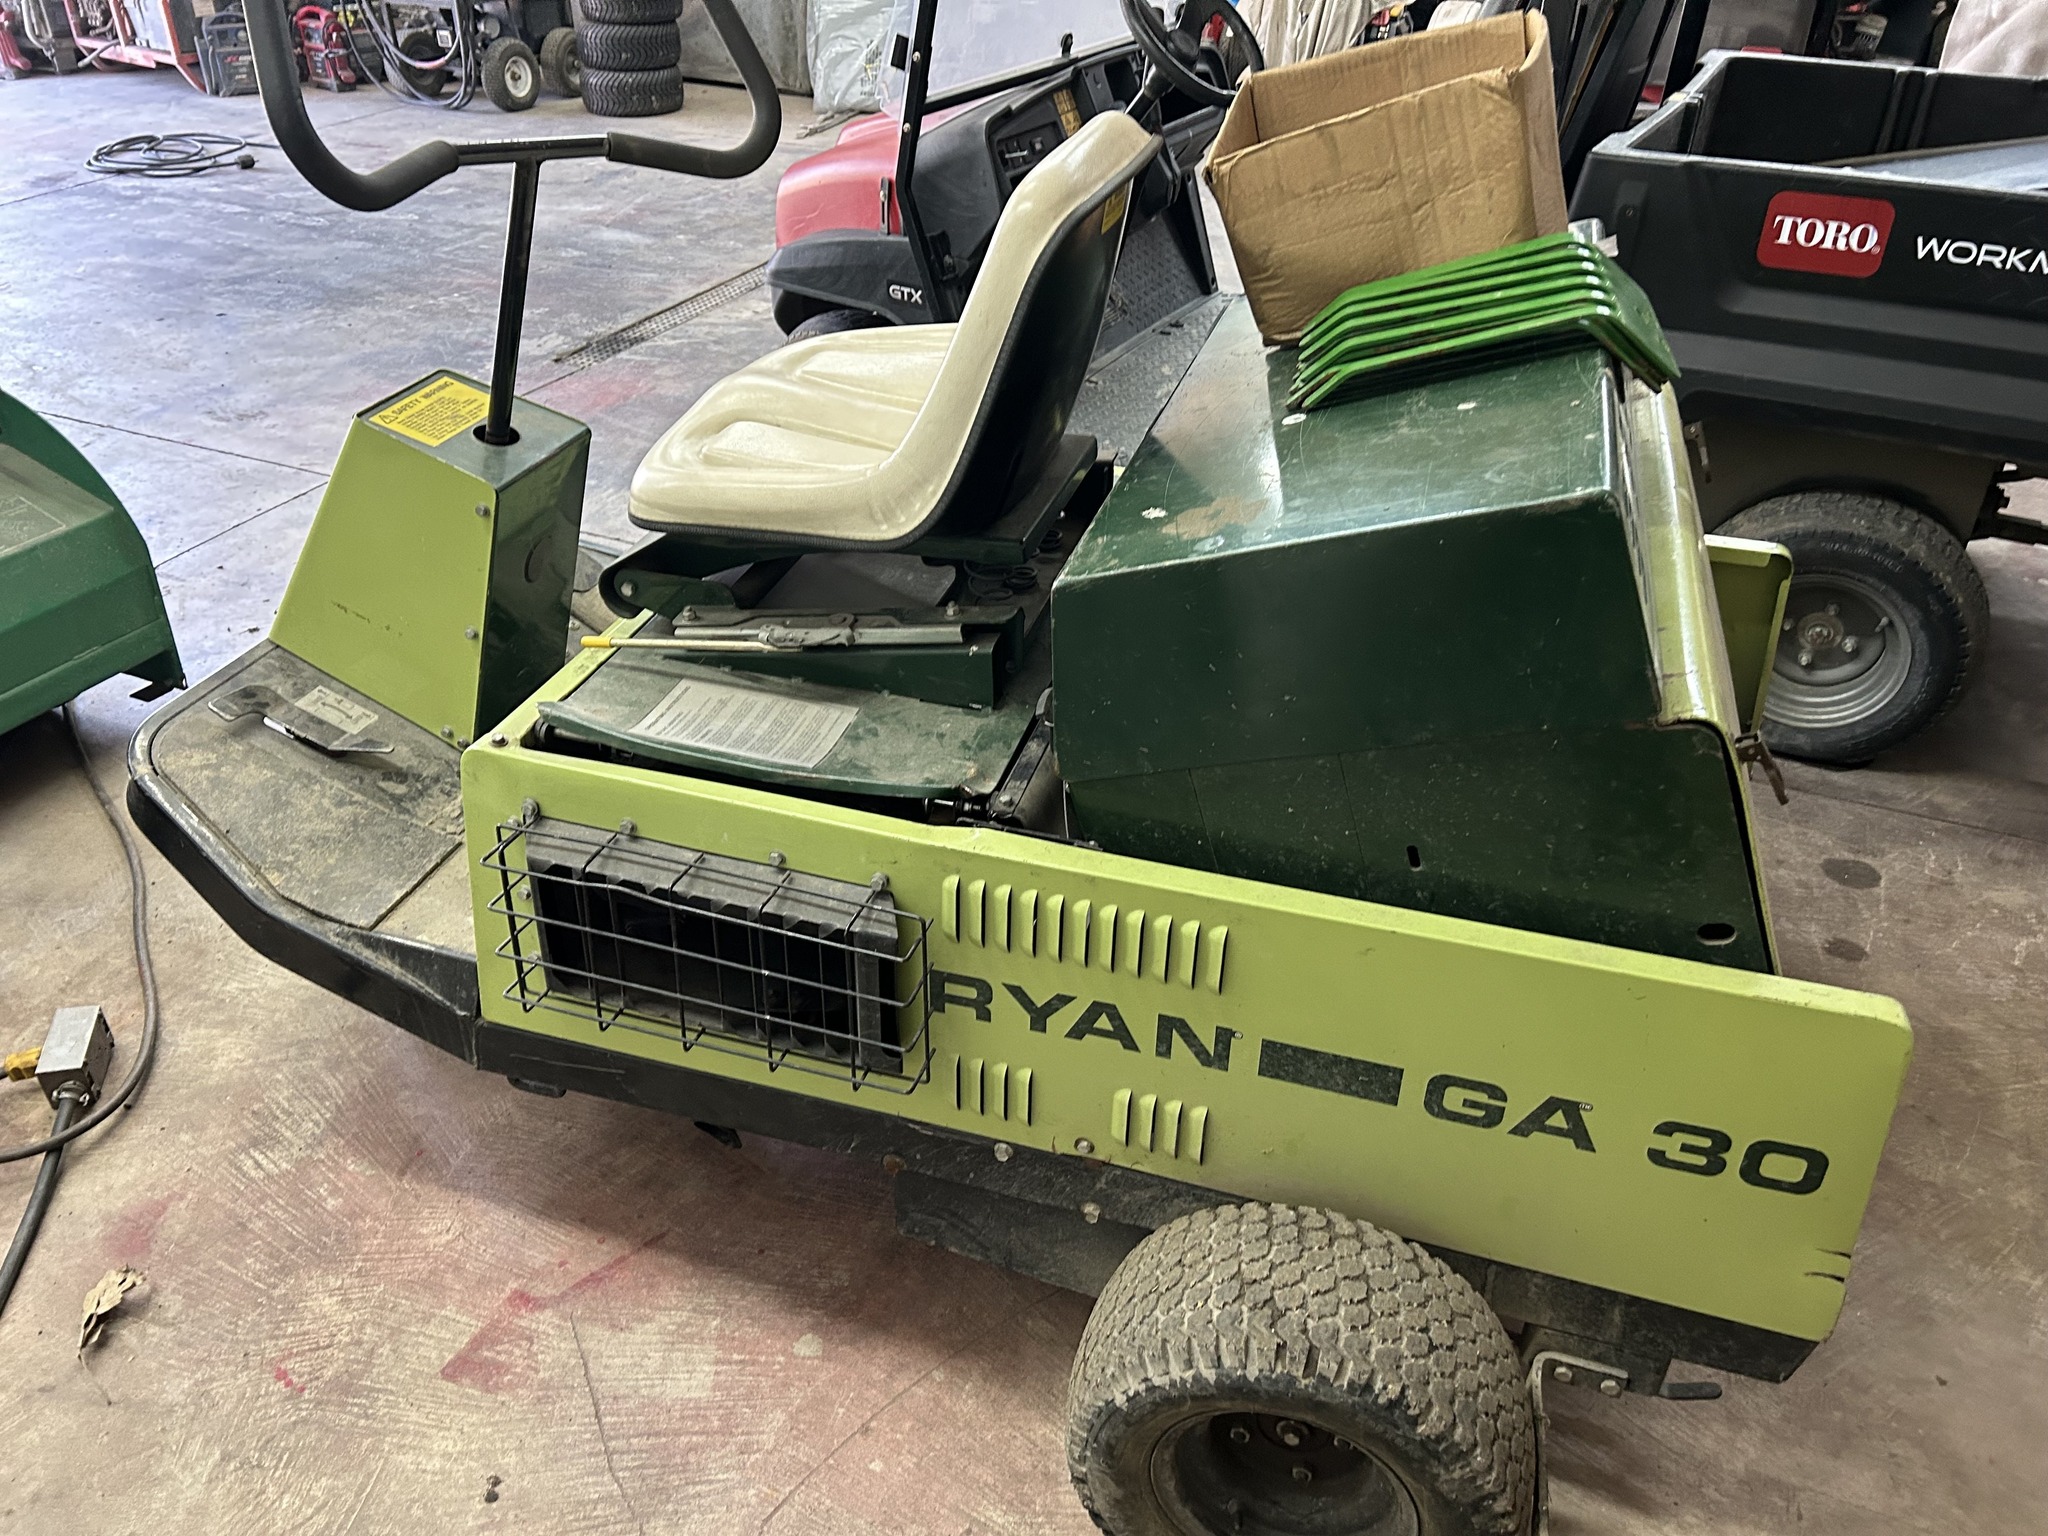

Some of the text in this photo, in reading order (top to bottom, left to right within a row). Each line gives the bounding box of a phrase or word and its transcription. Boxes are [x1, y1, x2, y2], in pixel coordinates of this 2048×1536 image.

[1772, 214, 1879, 254] TORO
[888, 284, 923, 305] GTX
[929, 968, 1830, 1196] RYAN GA 30
